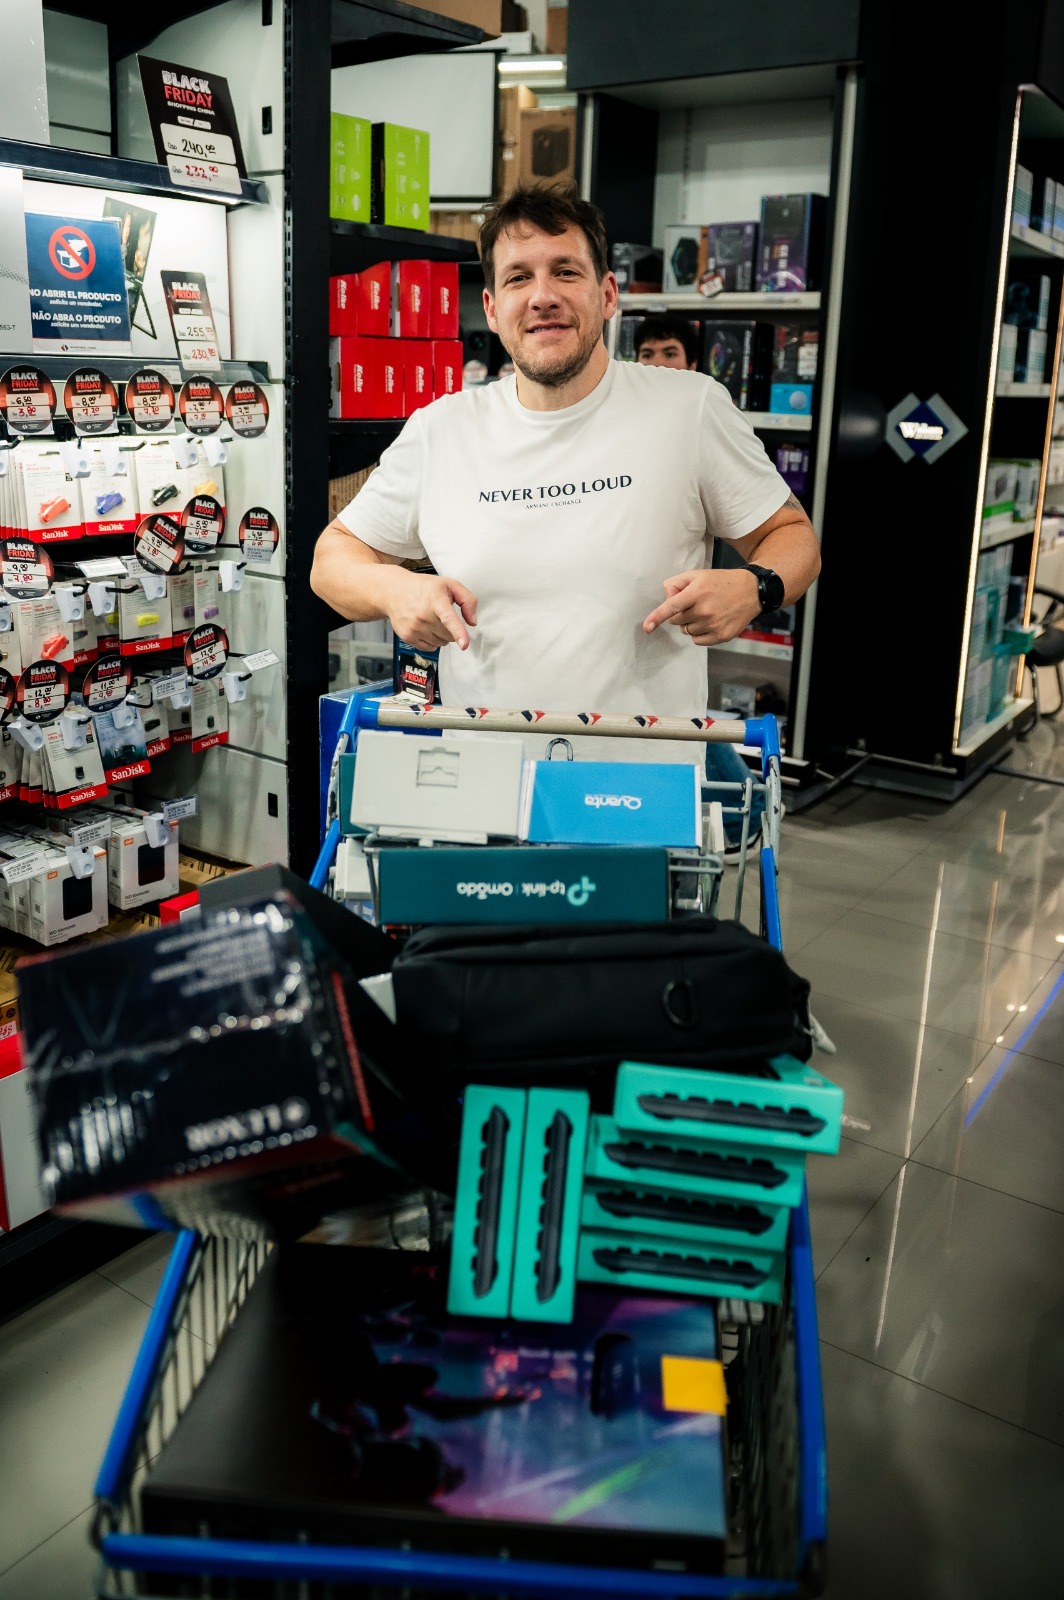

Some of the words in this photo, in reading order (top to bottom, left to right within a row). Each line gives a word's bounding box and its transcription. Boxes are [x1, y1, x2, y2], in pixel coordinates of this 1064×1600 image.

[162, 70, 211, 94] BLACK
[164, 85, 212, 109] FRIDAY
[171, 282, 201, 291] BLACK
[42, 289, 66, 298] ABRIR
[67, 290, 77, 299] EL
[78, 291, 122, 302] PRODUCTO
[173, 290, 203, 300] FRIDAY
[32, 310, 52, 321] NÃO
[52, 313, 75, 322] ABRA
[75, 314, 83, 322] O
[83, 315, 122, 324] PRODUTO
[10, 372, 38, 381] BLACK
[11, 380, 39, 388] FRIDAY
[75, 381, 102, 390] FRIDAY
[137, 382, 160, 391] FRIDAY
[189, 382, 211, 390] BLACK
[190, 388, 211, 398] FRIDAY
[478, 488, 534, 503] NEVER
[536, 483, 576, 499] TOO
[581, 474, 633, 494] LOUD
[195, 499, 216, 509] BLACK
[194, 505, 216, 516] FRIDAY
[250, 512, 269, 520] BLACK
[156, 517, 179, 536] BLACK
[249, 518, 269, 526] FRIDAY
[99, 523, 125, 534] SanDisk
[152, 524, 175, 542] FRIDAY
[43, 530, 70, 540] SanDisk
[7, 543, 35, 553] BLACK
[7, 550, 36, 559] FRIDAY
[194, 628, 214, 641] BLACK
[135, 641, 161, 652] SanDisk
[194, 634, 215, 649] FRIDAY
[31, 666, 56, 676] BLACK
[98, 660, 122, 671] BLACK
[30, 672, 57, 683] FRIDAY
[97, 666, 121, 680] FRIDAY
[404, 671, 428, 686] FRIDAY
[173, 733, 193, 743] SanDis
[201, 737, 221, 750] SanDisk
[111, 765, 146, 781] SanDisk
[70, 789, 97, 804] SanDisk
[584, 793, 642, 810] Quanta
[521, 880, 565, 896] tp-link
